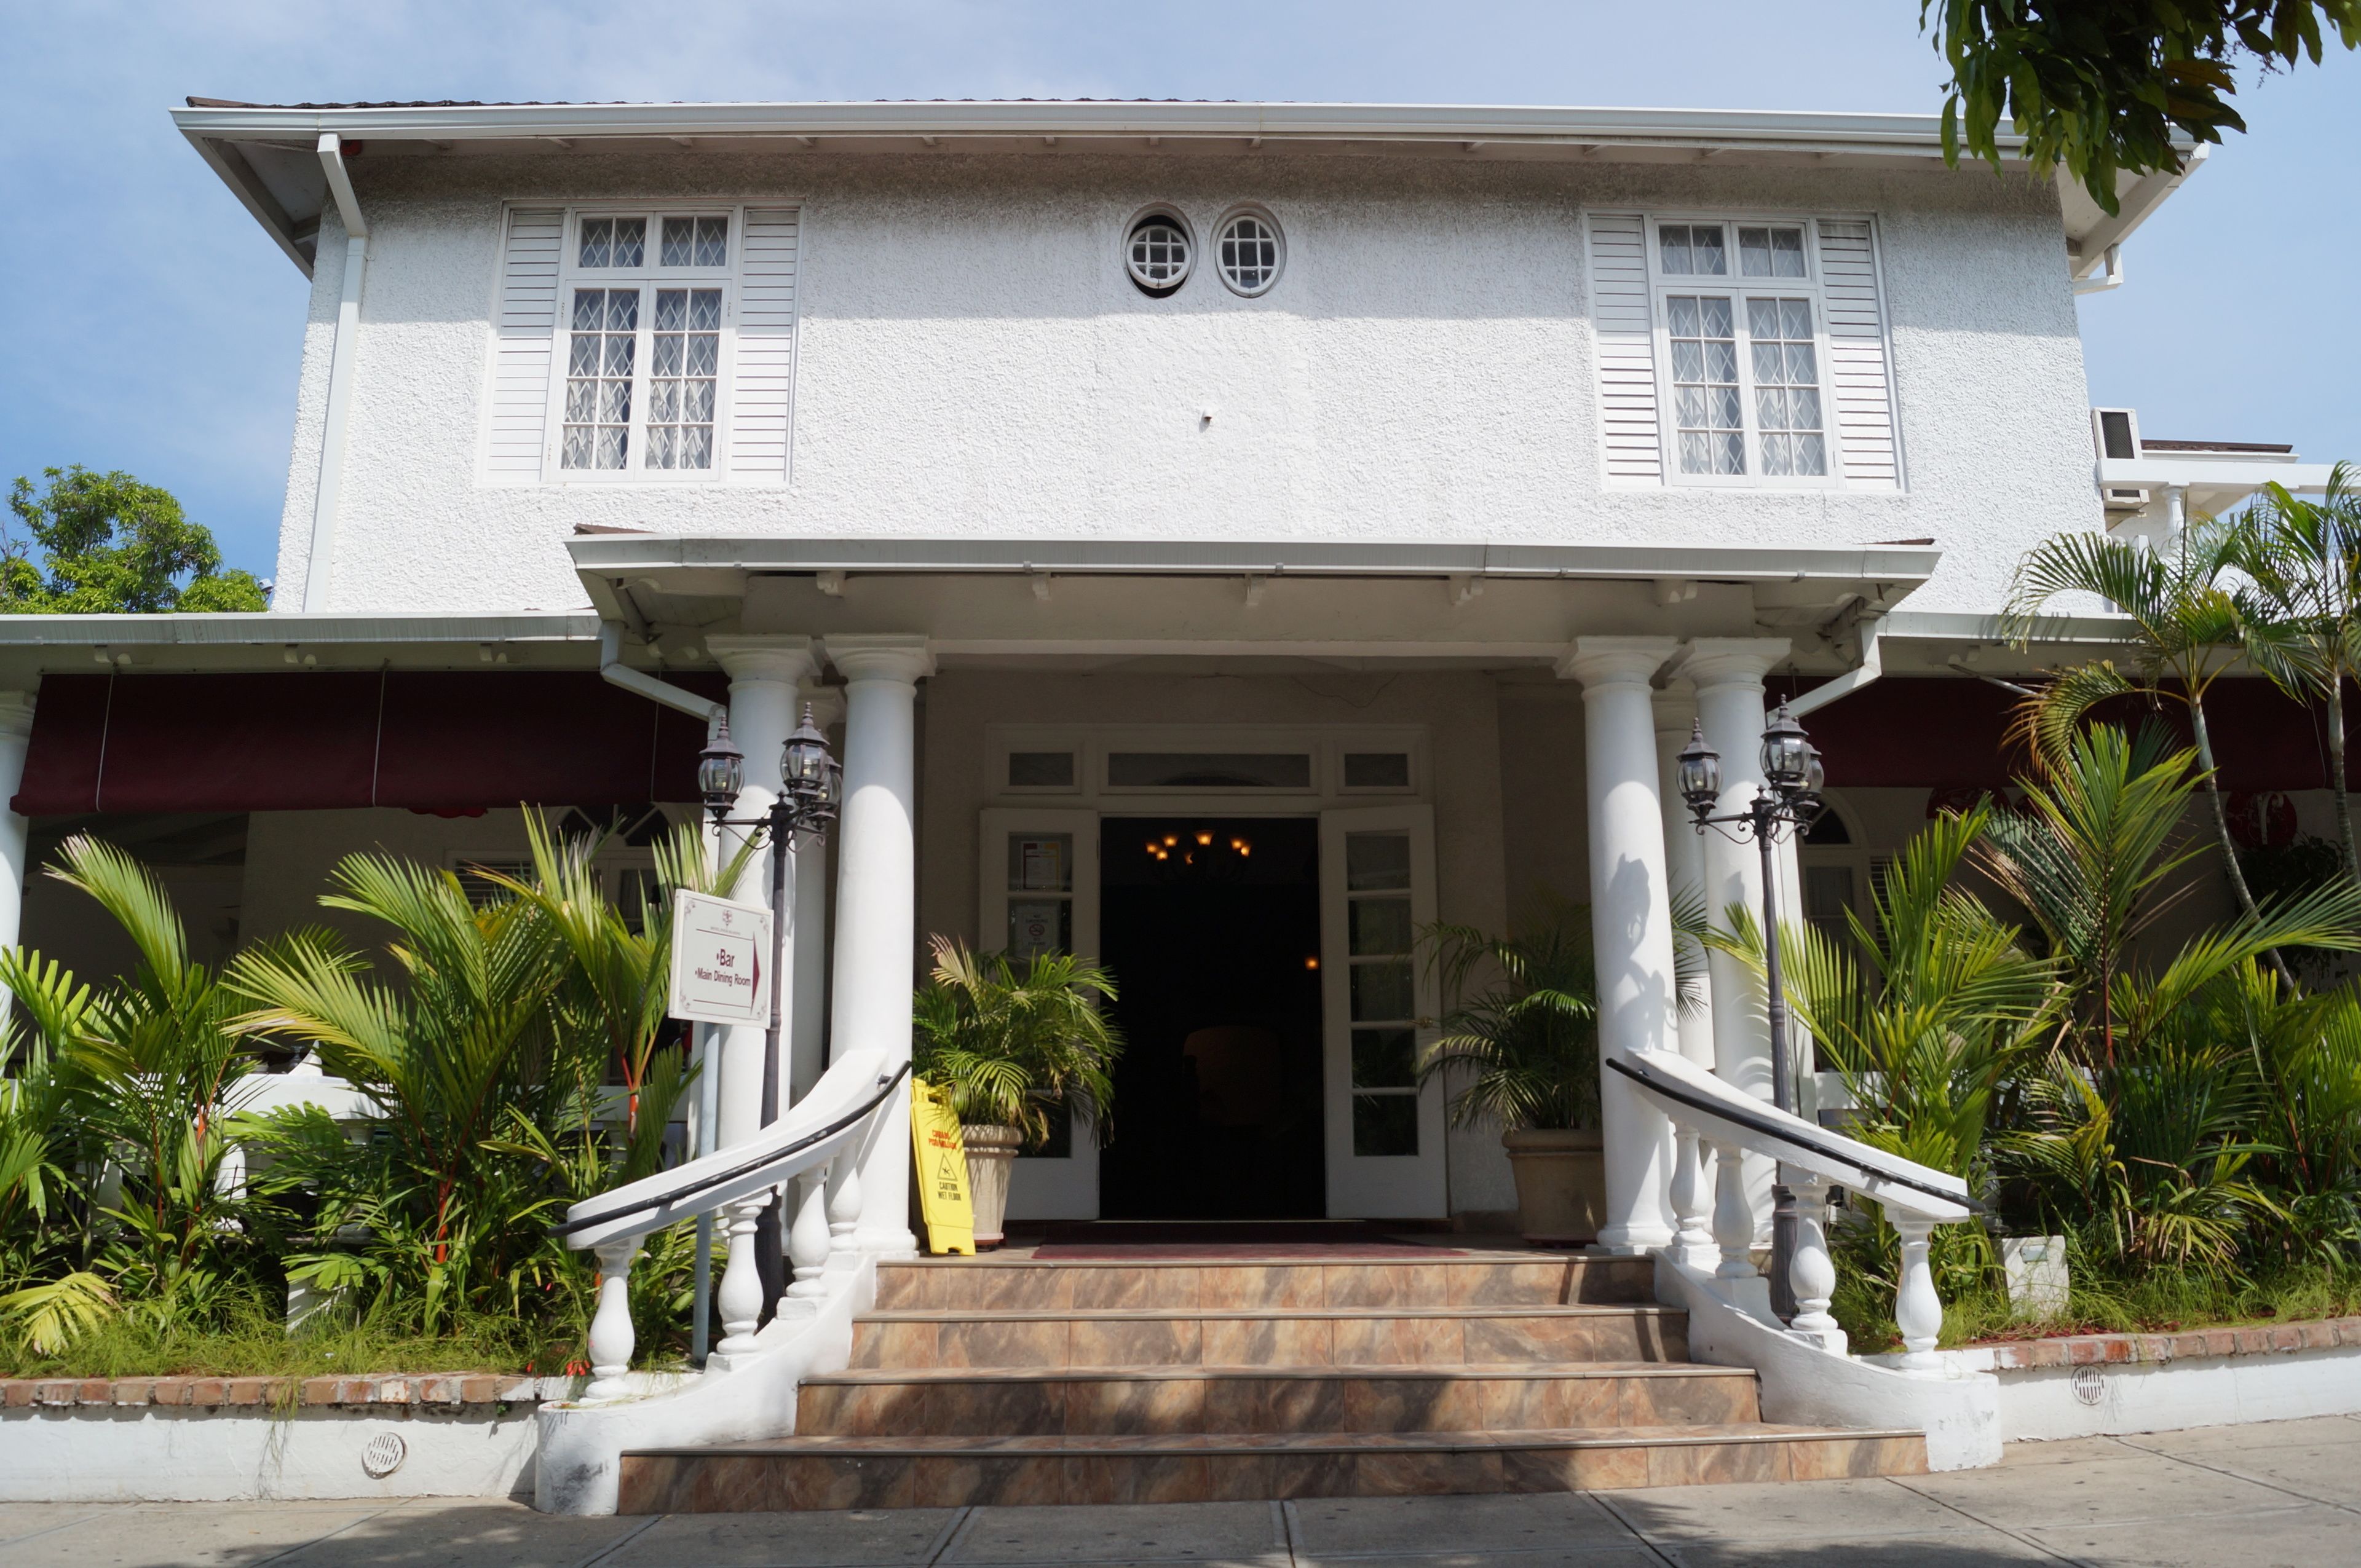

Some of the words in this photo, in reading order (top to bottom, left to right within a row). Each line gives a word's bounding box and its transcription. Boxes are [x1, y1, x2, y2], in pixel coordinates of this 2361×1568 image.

[720, 948, 735, 967] Bar
[697, 967, 712, 980] Main
[714, 970, 732, 987] Dining
[735, 973, 751, 987] Room
[939, 1181, 958, 1191] CAUTION
[938, 1191, 947, 1200] WET
